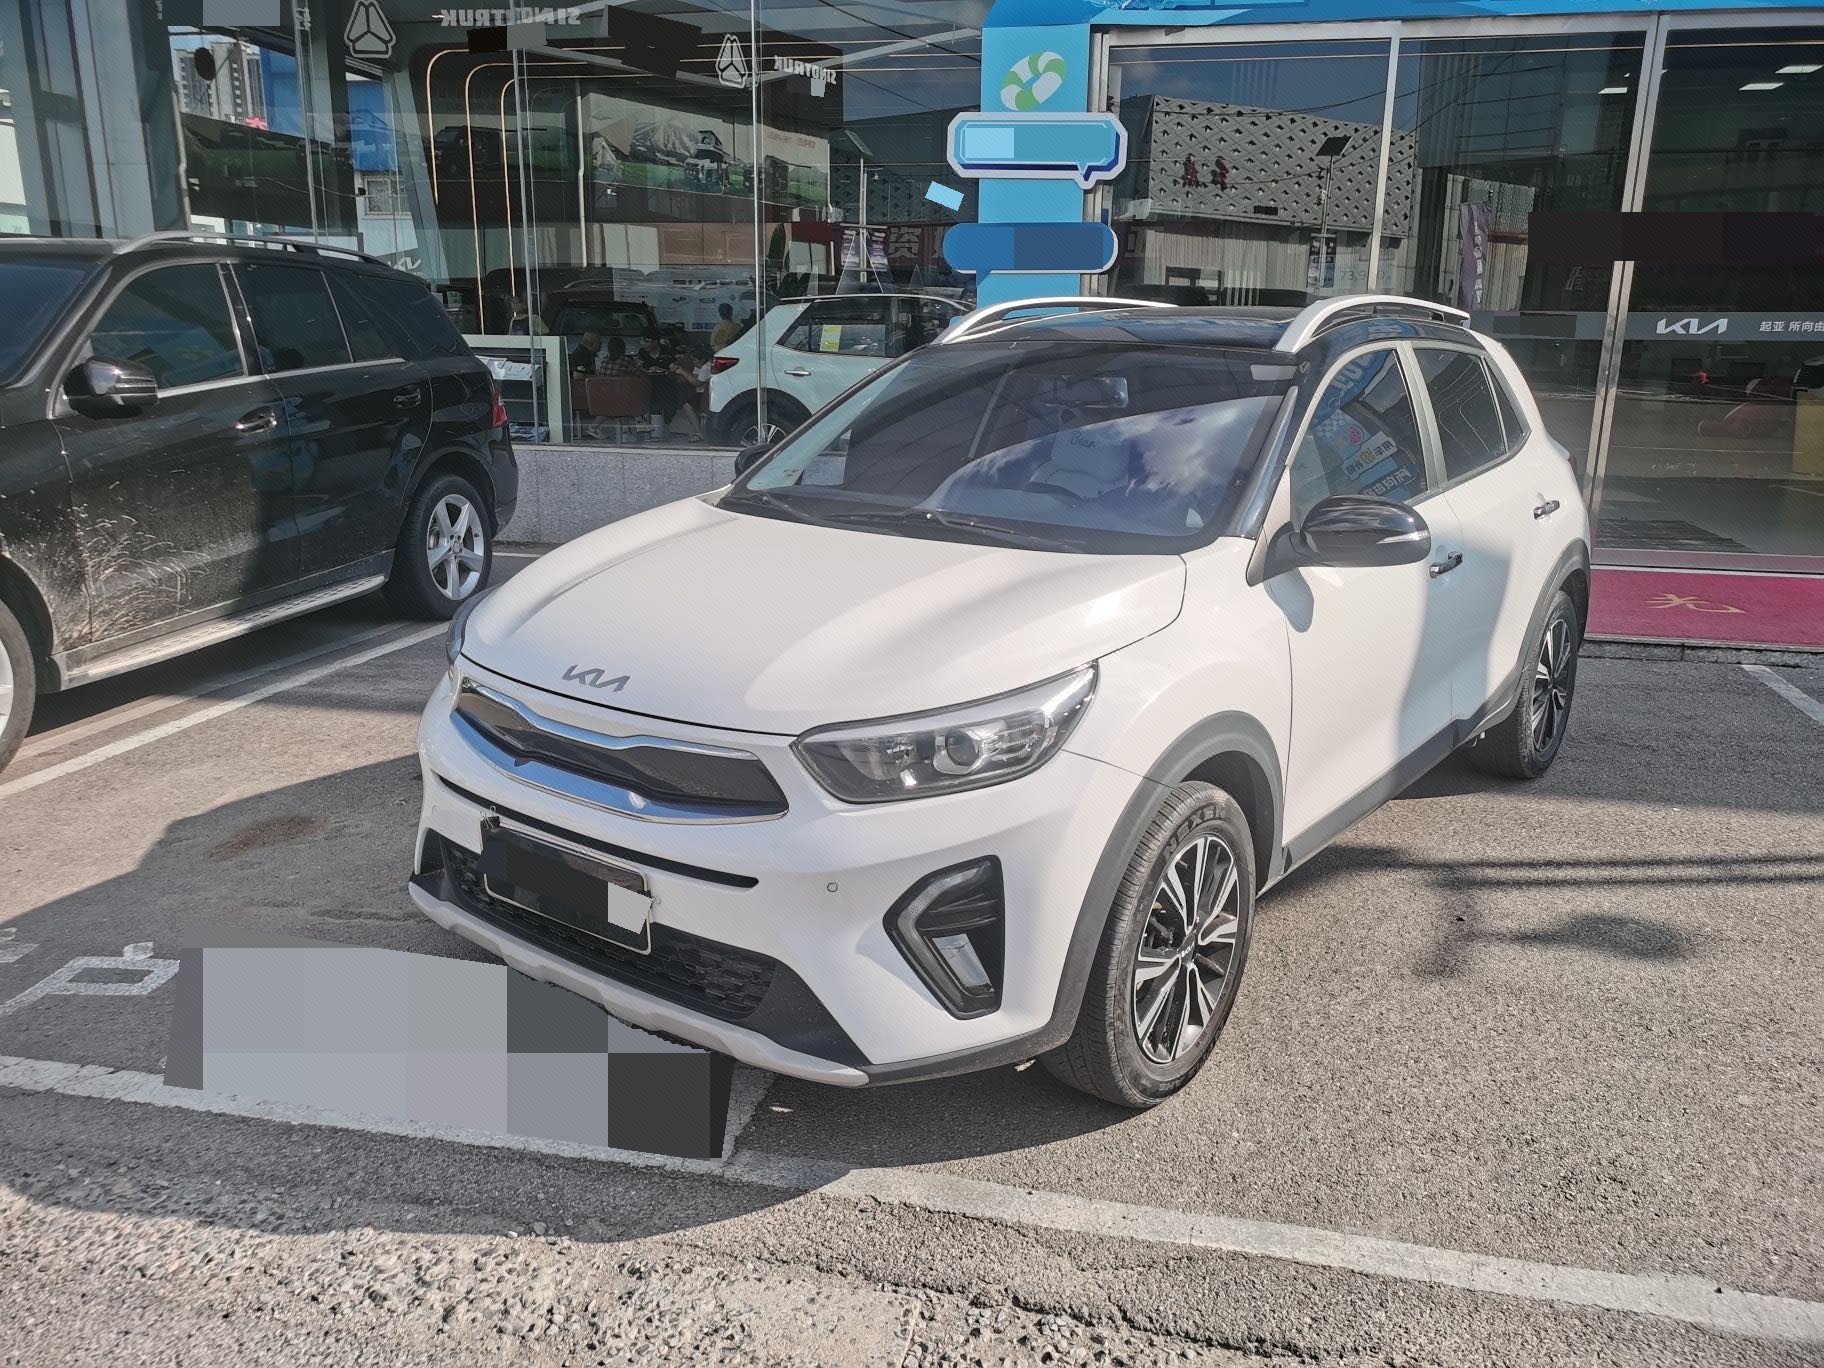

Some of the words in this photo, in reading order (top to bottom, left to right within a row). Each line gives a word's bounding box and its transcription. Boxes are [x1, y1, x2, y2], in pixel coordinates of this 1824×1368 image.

[1656, 318, 1729, 335] KIA
[1759, 320, 1785, 332] 起亚
[1788, 320, 1824, 333] 所向由
[562, 663, 632, 693] KIA
